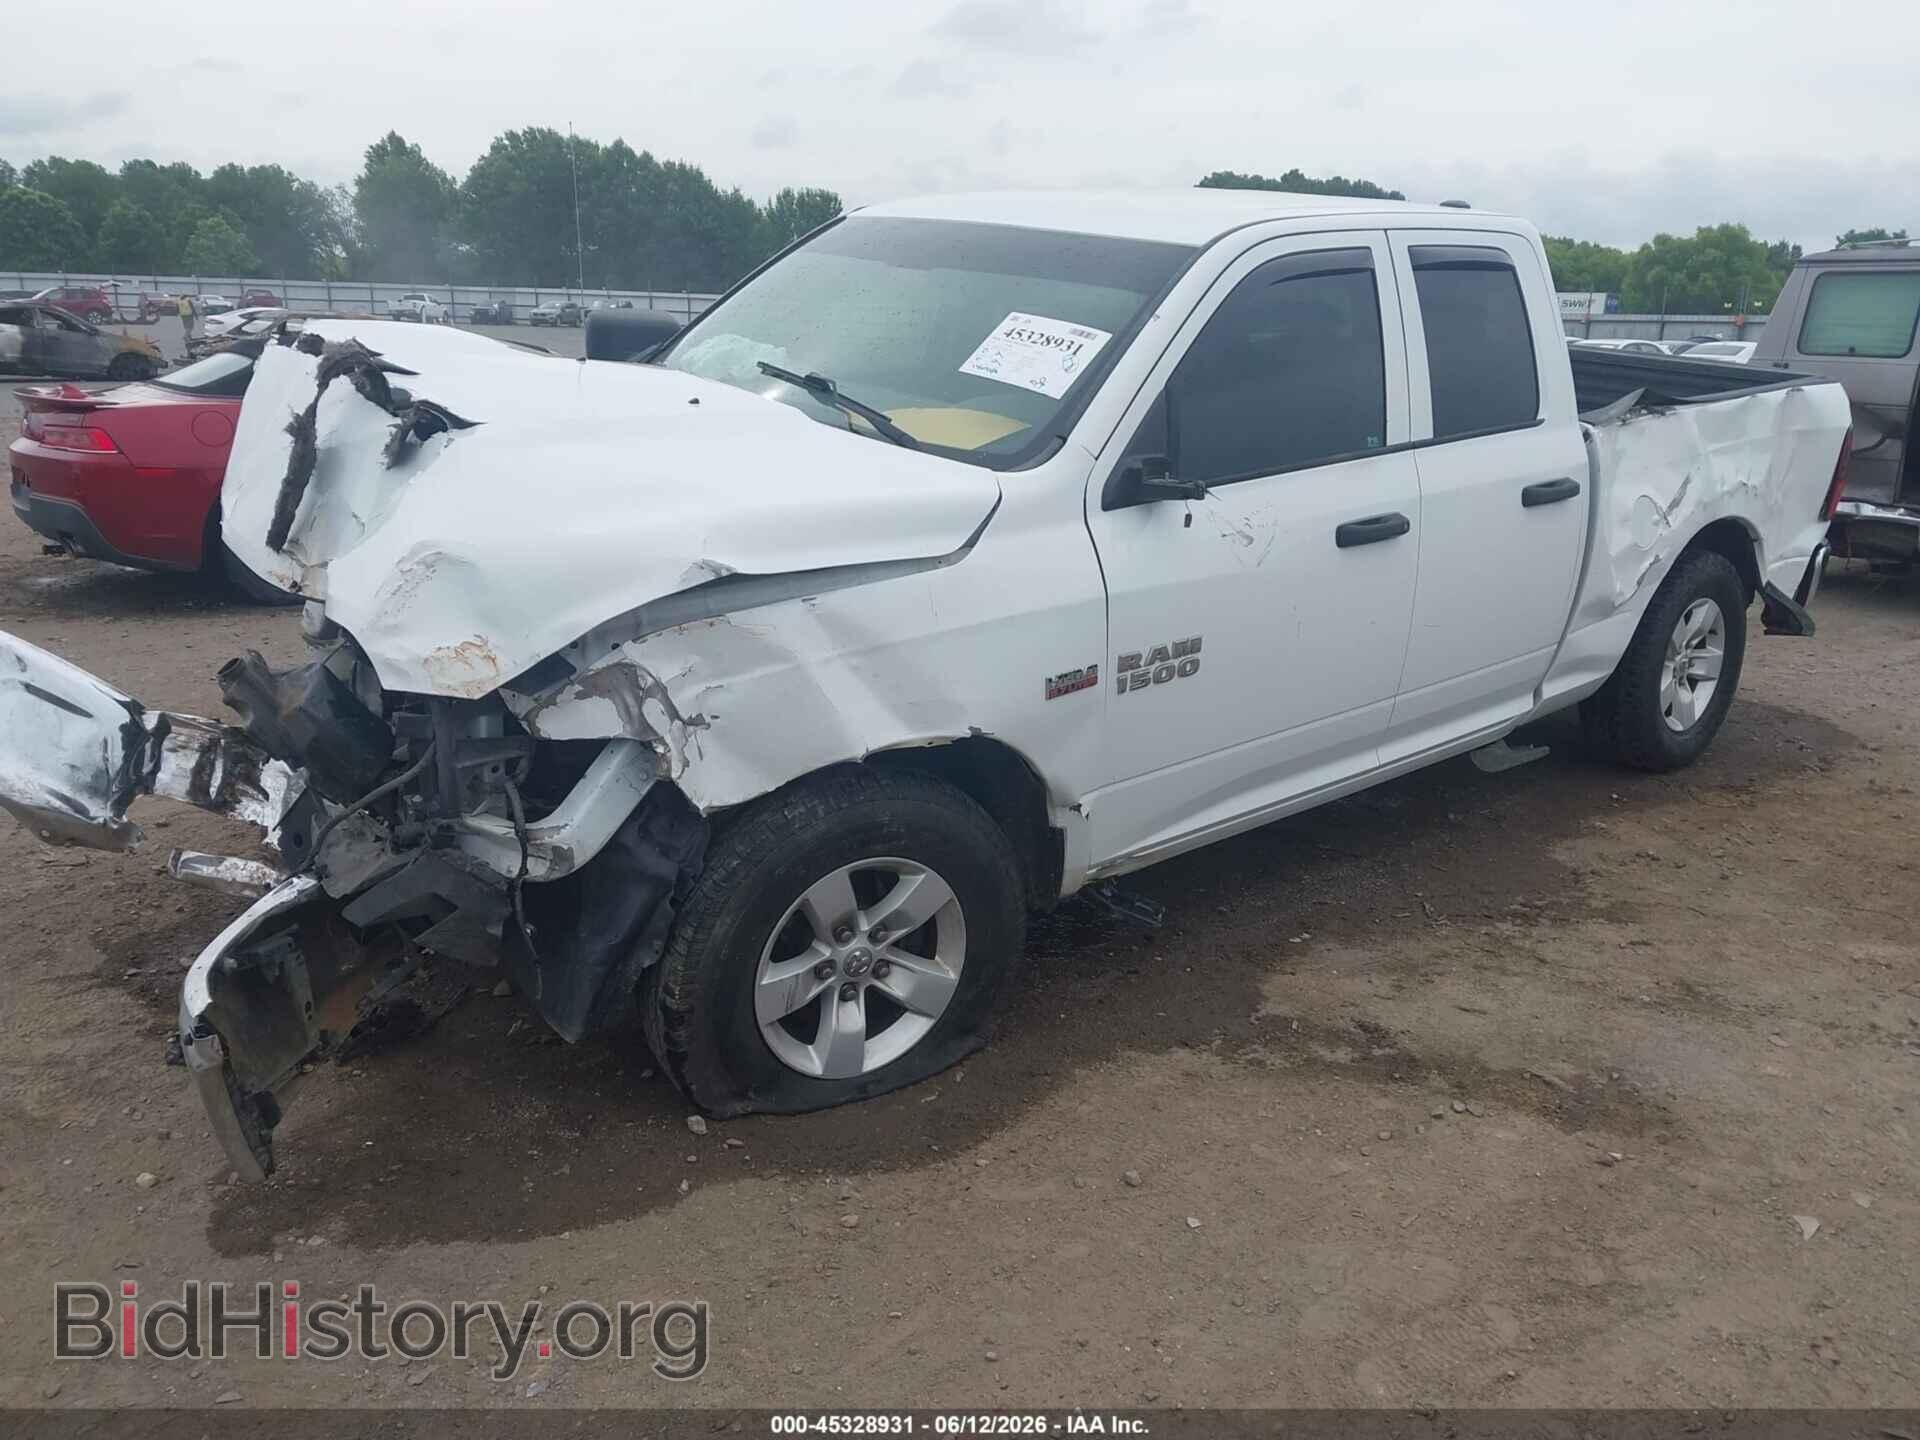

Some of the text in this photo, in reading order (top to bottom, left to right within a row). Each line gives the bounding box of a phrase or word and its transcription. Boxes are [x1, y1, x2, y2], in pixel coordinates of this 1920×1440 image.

[1003, 327, 1084, 356] 45328931
[1116, 635, 1203, 674] RAM
[1116, 657, 1201, 696] 1500
